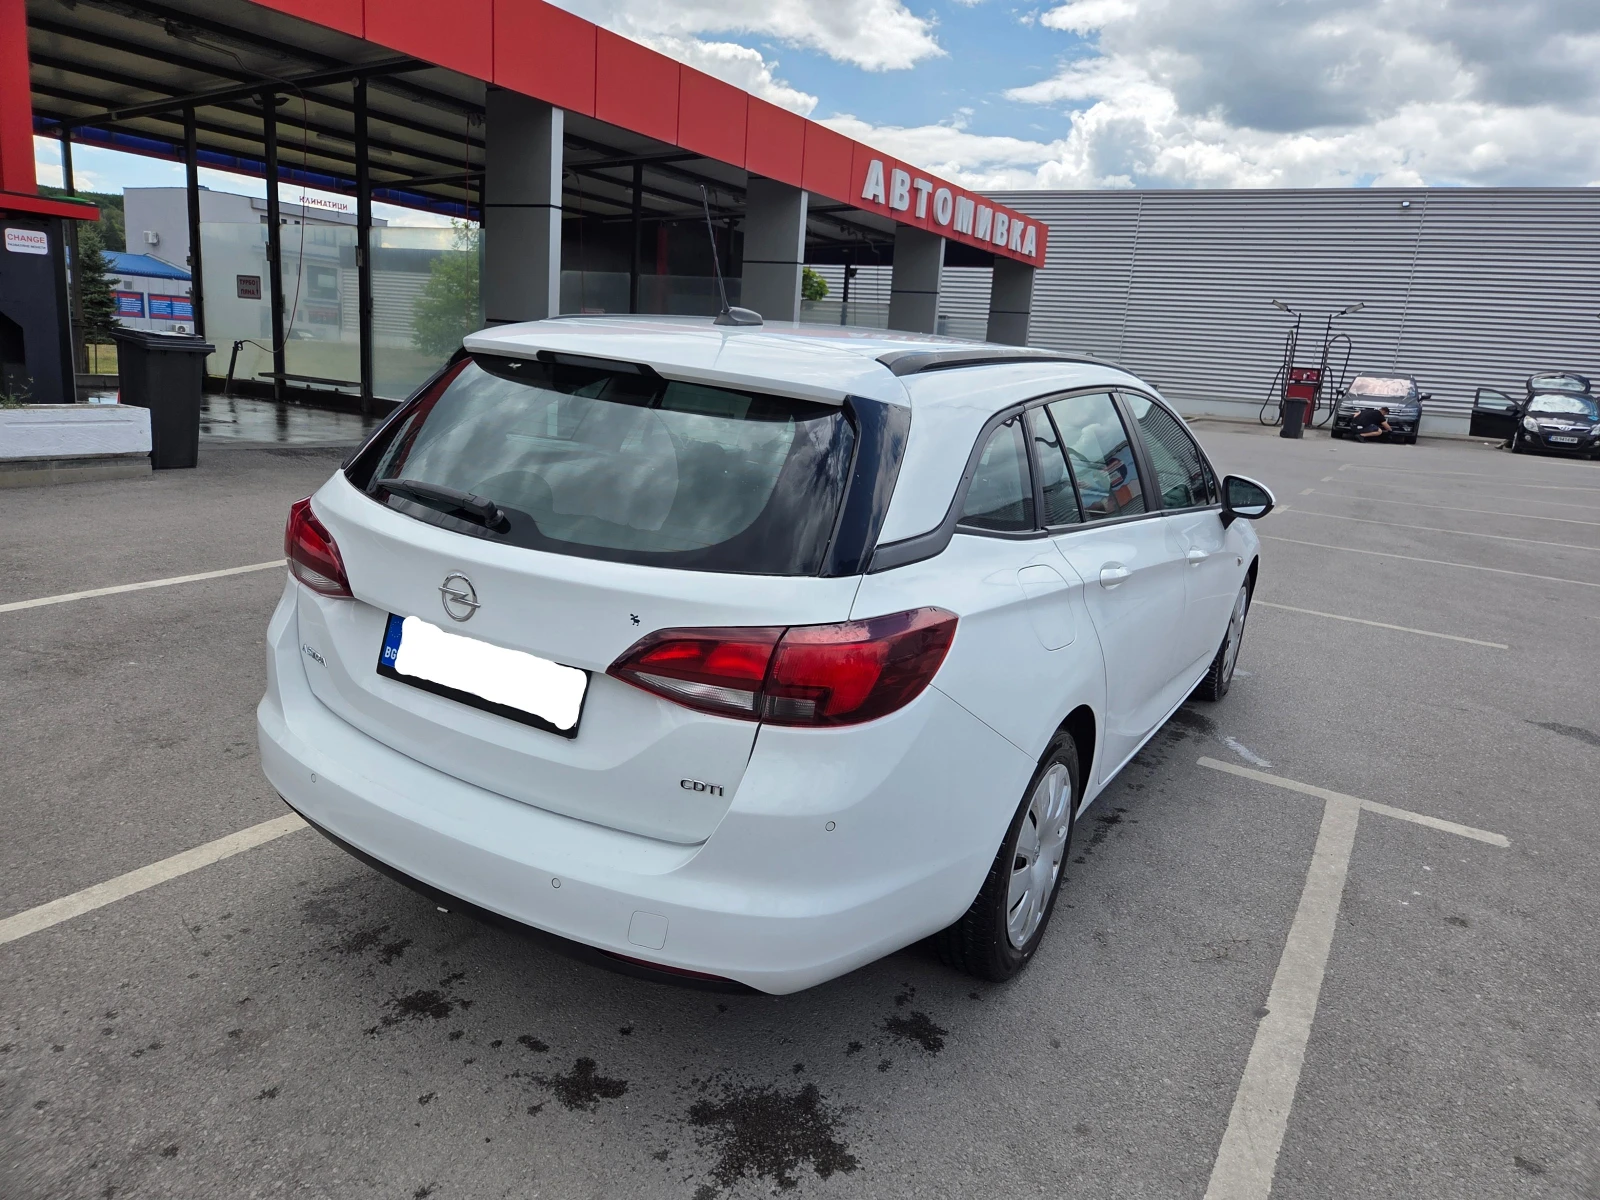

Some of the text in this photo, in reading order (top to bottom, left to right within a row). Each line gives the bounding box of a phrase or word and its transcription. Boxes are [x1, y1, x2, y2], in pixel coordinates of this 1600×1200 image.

[299, 196, 348, 210] КЛИМАТИЦИ
[862, 159, 1036, 257] АВТОМИВКА
[7, 233, 45, 244] CHANGE
[384, 646, 397, 660] BG
